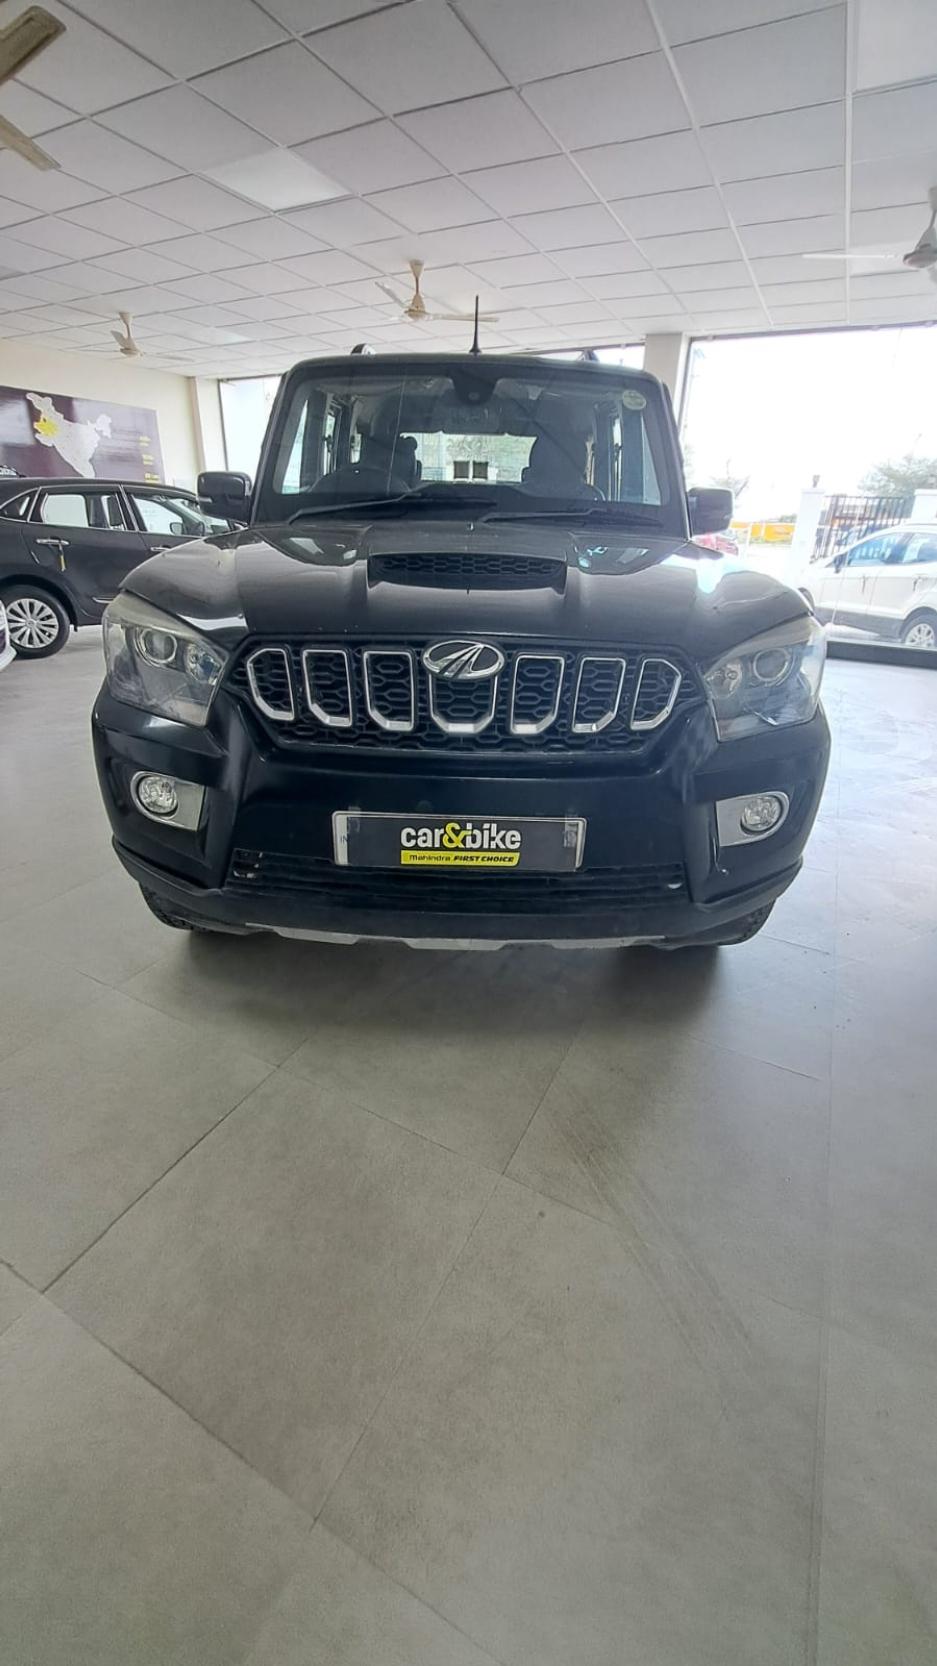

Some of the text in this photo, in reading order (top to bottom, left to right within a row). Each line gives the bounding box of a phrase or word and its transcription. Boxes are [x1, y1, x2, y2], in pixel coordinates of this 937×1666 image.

[400, 822, 521, 850] car&bike
[453, 855, 480, 863] FIRST
[481, 855, 514, 863] CHOICE
